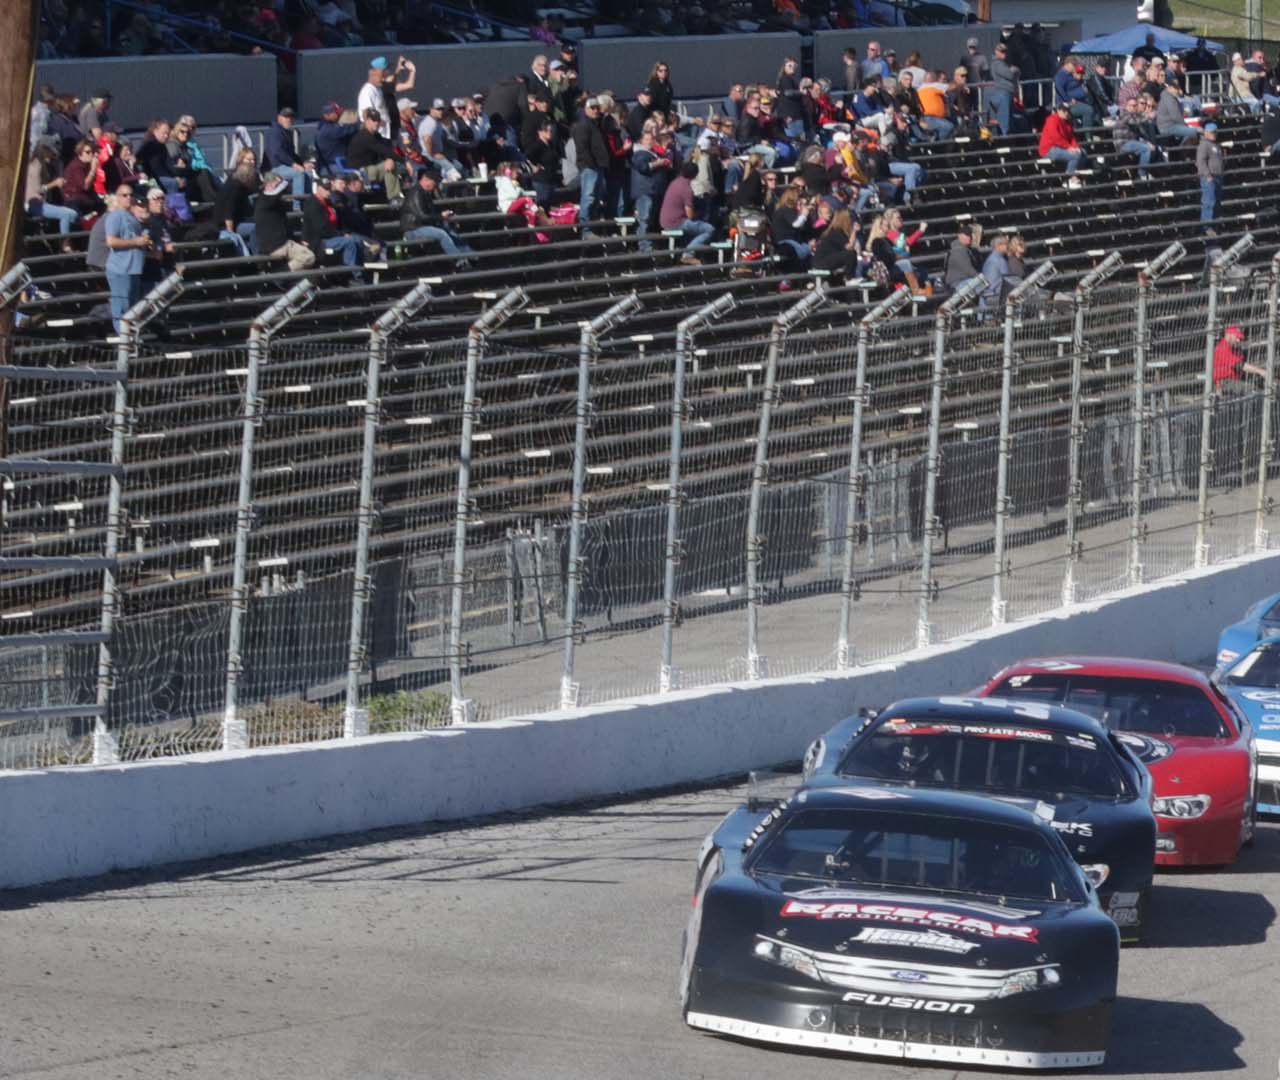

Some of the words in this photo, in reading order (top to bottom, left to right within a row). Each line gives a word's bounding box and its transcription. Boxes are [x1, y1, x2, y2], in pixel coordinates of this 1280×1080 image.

[964, 726, 987, 735] PRO
[989, 727, 1014, 736] LATE
[1016, 730, 1053, 741] MODEL
[782, 900, 1039, 943] RACECAR
[821, 912, 995, 937] ENGINEERING
[842, 991, 975, 1015] FUSION
